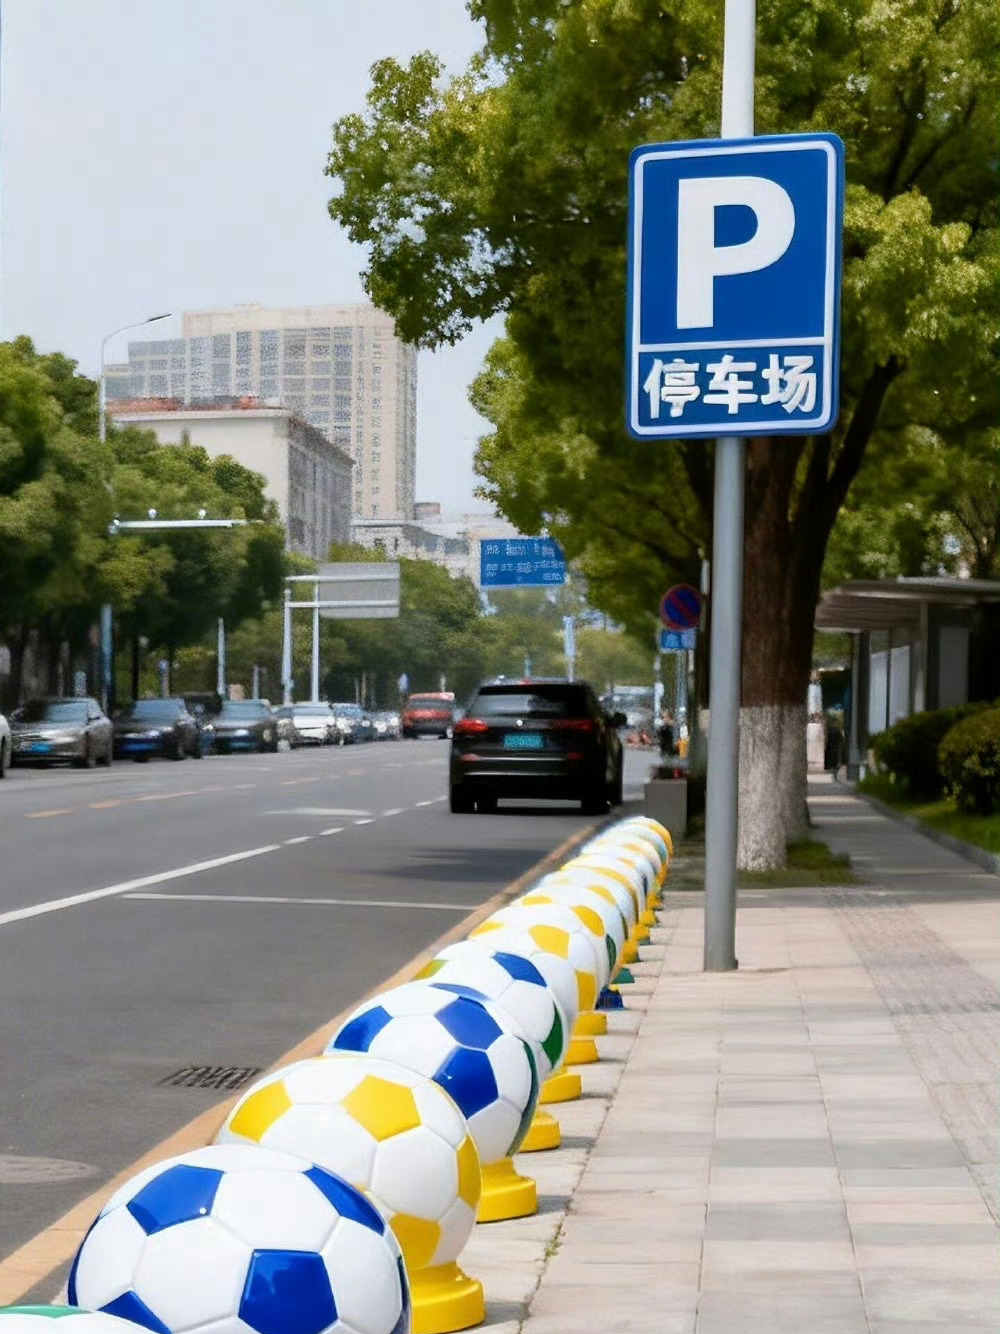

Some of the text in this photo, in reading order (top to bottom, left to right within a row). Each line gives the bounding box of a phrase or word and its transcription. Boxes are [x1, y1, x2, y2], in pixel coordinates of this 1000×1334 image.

[676, 175, 796, 330] P
[643, 353, 817, 419] 停车场
